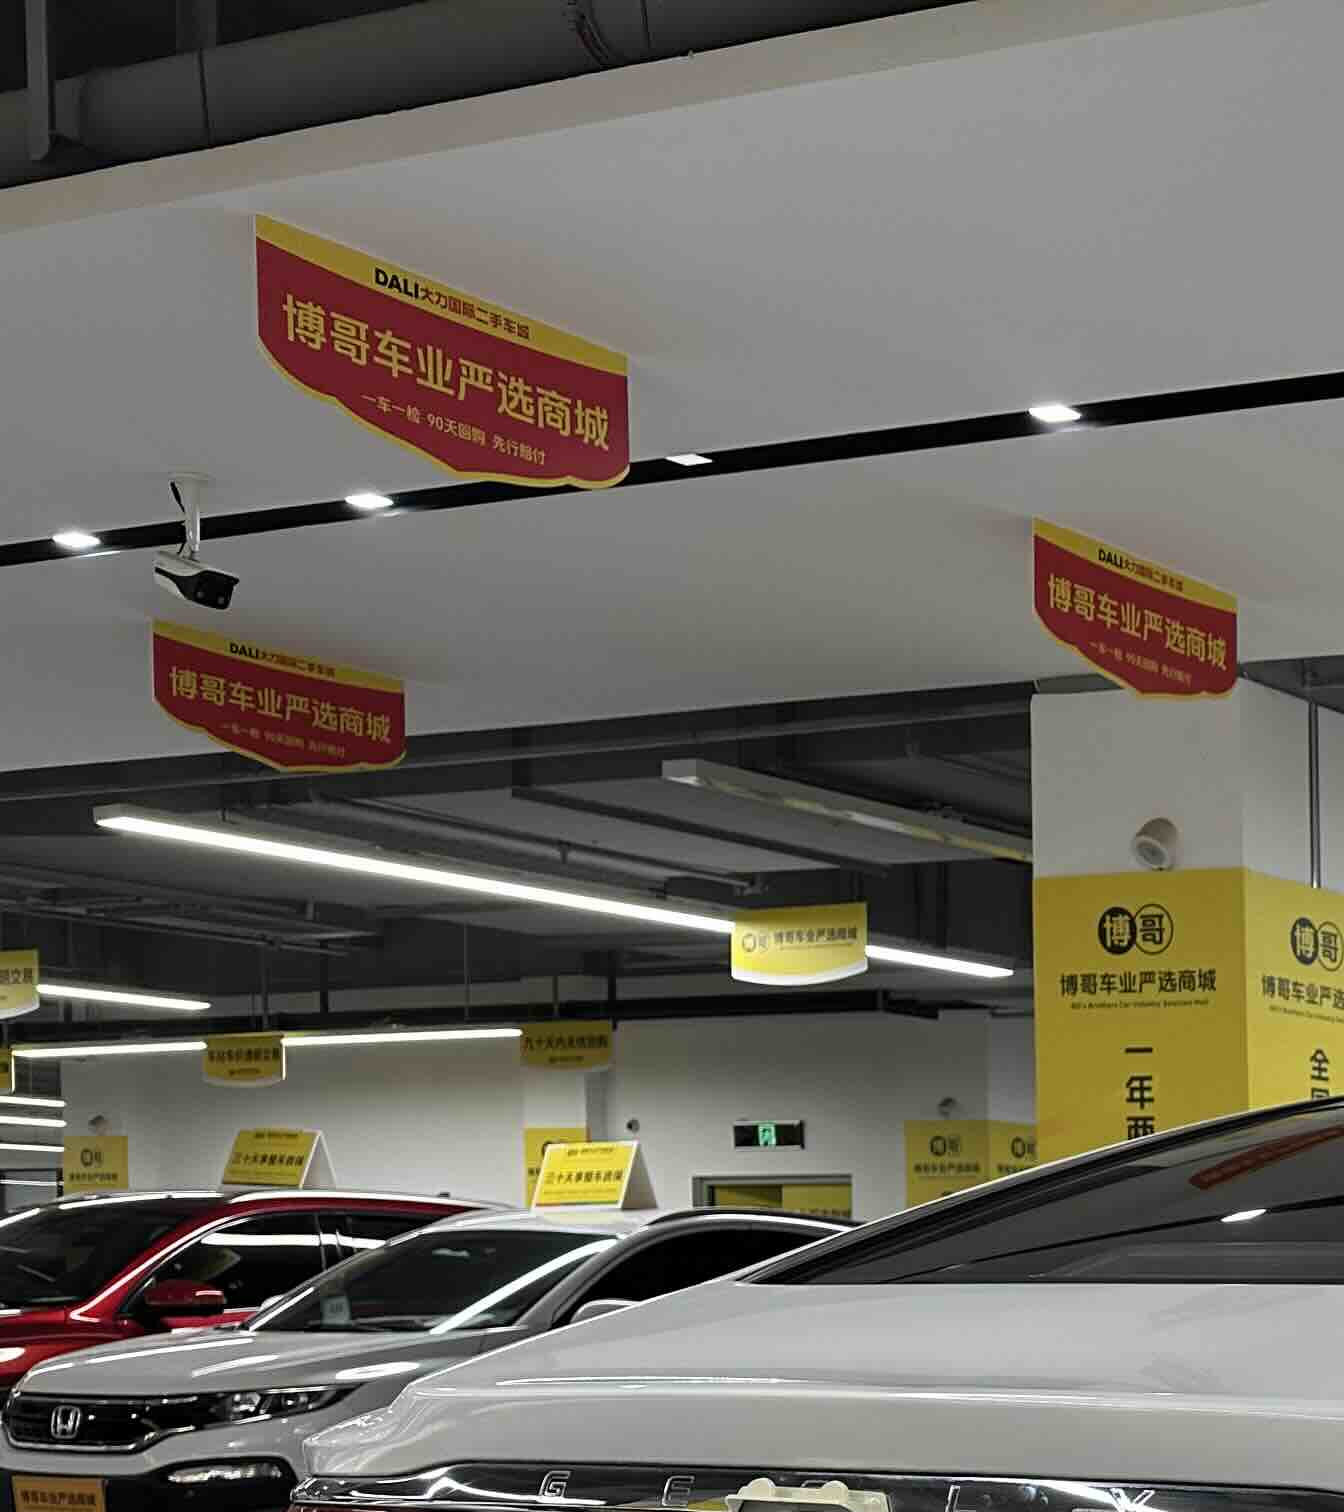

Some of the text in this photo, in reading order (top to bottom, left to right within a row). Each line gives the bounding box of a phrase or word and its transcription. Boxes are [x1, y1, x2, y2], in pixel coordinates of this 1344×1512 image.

[281, 293, 609, 451] 博哥车业严选商城
[1048, 572, 1228, 671] 博哥车业严选商城
[169, 666, 391, 744] 博哥车业严选商城
[1059, 968, 1217, 997] 博哥车业严选商城
